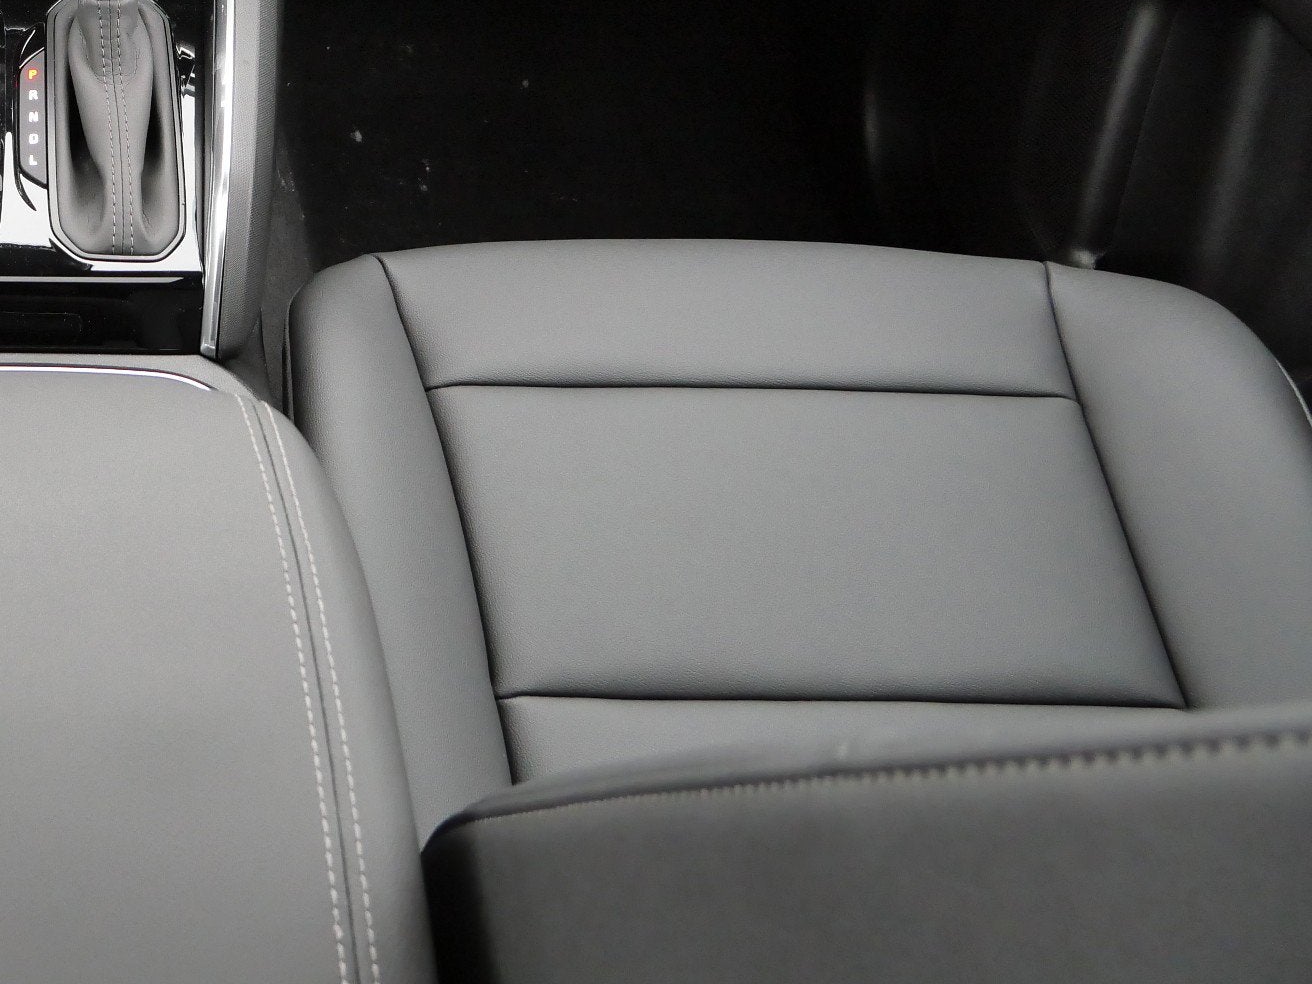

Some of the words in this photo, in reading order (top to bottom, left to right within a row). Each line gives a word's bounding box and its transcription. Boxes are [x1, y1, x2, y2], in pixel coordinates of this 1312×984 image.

[28, 69, 38, 80] P
[29, 90, 38, 100] R
[29, 111, 38, 122] N
[29, 134, 38, 144] D
[29, 155, 37, 165] L
